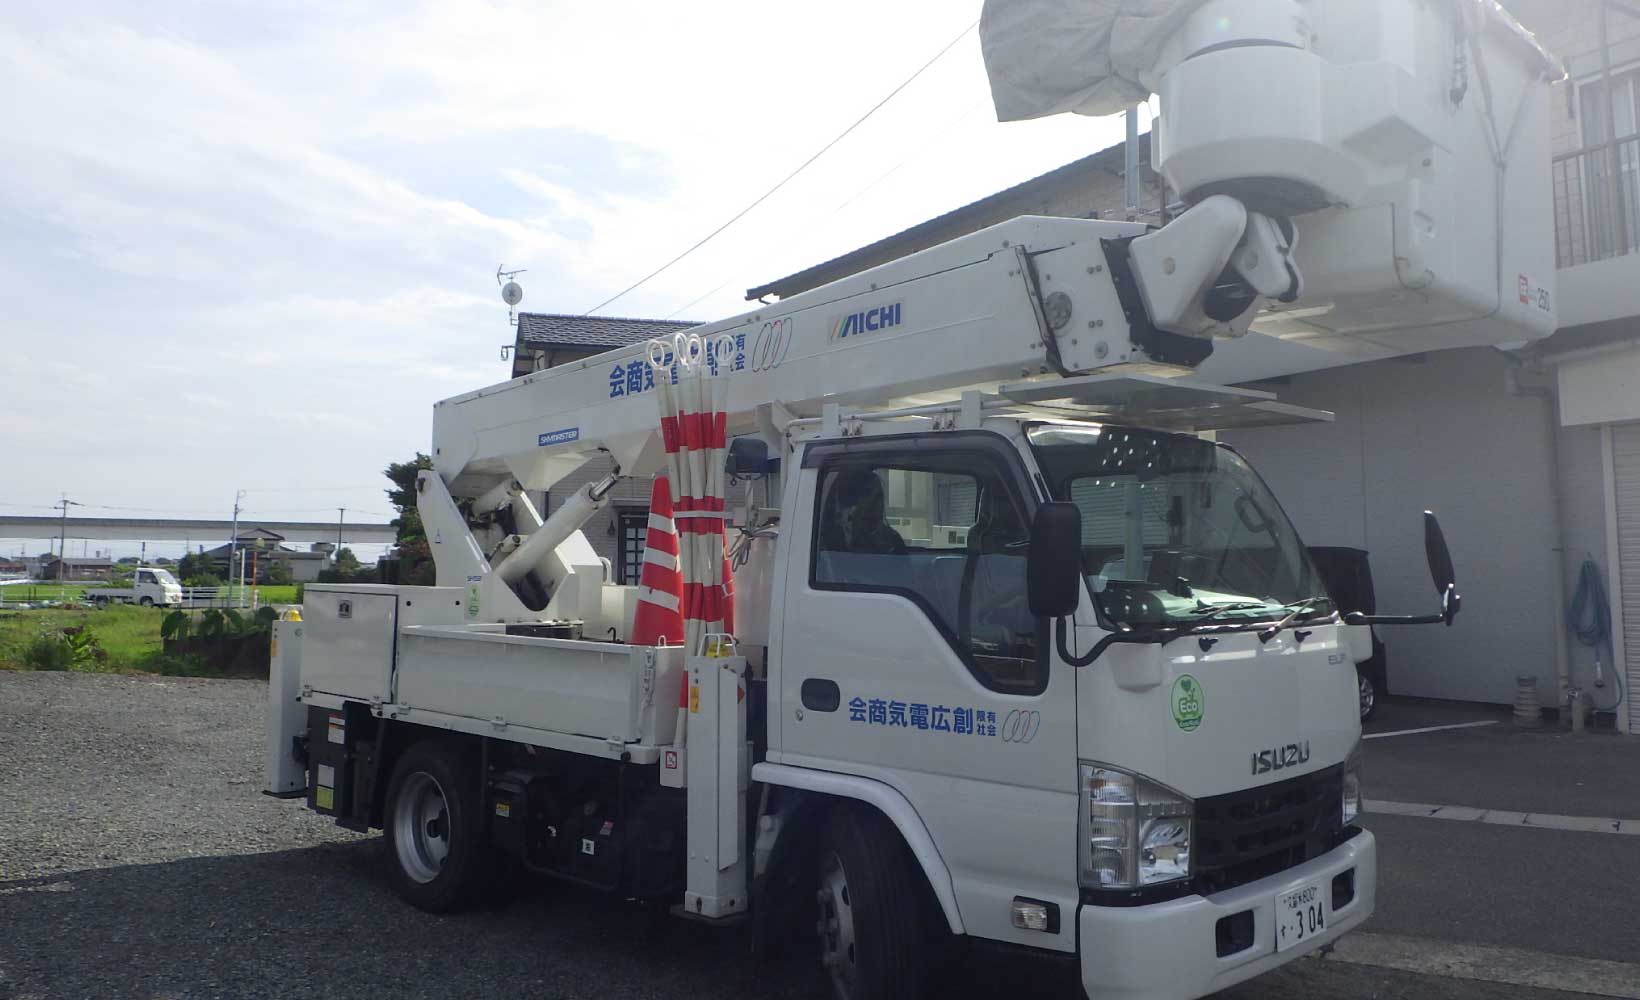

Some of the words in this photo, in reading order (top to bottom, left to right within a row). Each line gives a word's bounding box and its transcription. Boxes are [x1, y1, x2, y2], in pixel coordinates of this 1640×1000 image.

[839, 303, 901, 338] AICHI
[1179, 699, 1198, 713] Eco
[1251, 740, 1310, 775] ISUZU
